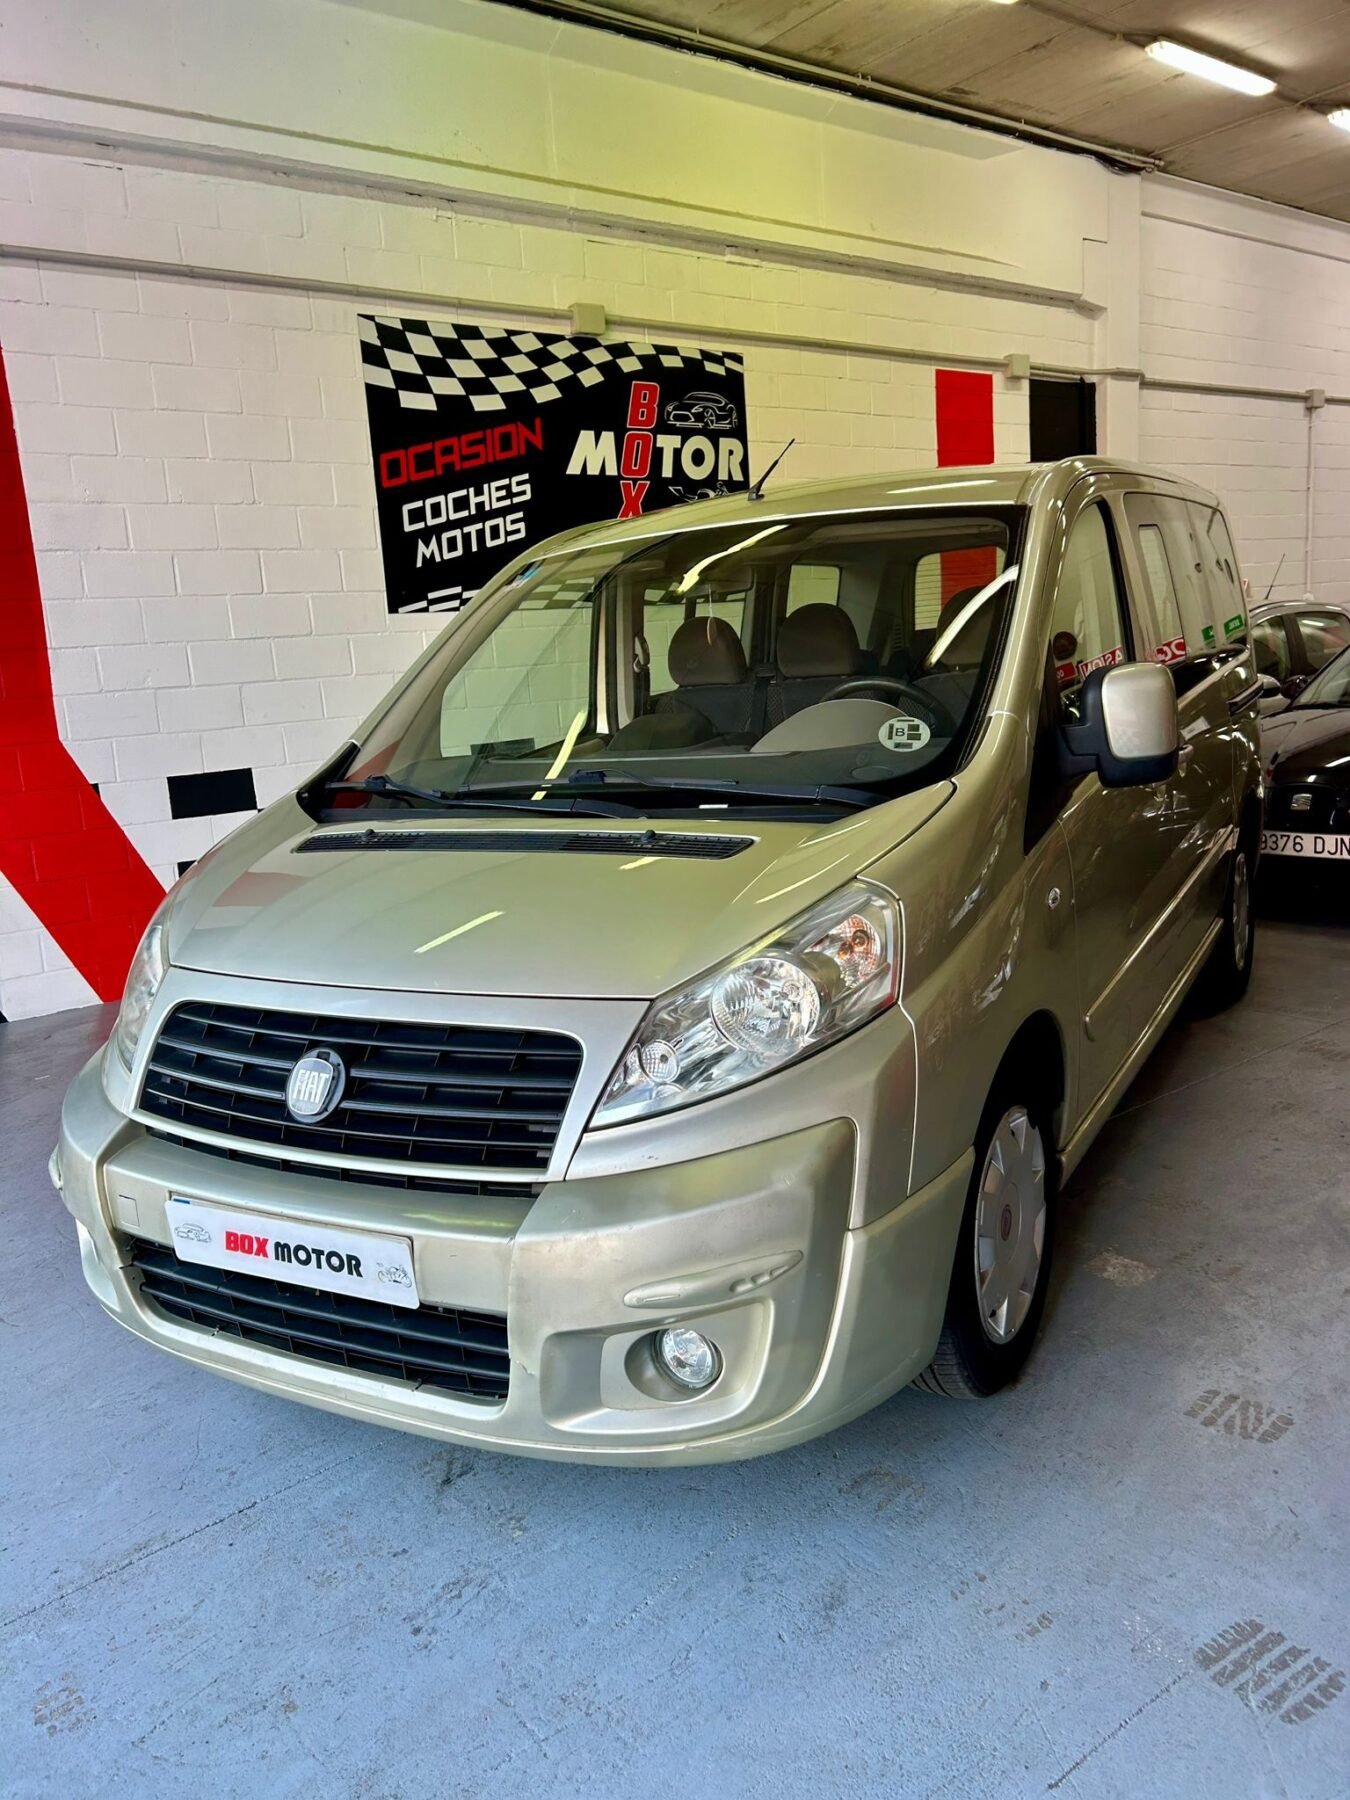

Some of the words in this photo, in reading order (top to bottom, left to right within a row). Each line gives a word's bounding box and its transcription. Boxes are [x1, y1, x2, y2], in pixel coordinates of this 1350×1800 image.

[379, 417, 544, 489] OCASION
[617, 381, 660, 520] BOX
[402, 473, 532, 533] COCHES
[416, 511, 527, 568] MOTOS
[895, 727, 906, 737] B
[1313, 836, 1350, 857] DJN
[293, 1069, 330, 1104] FIAT
[225, 1230, 270, 1259] BOX
[274, 1241, 364, 1278] MOTOR
